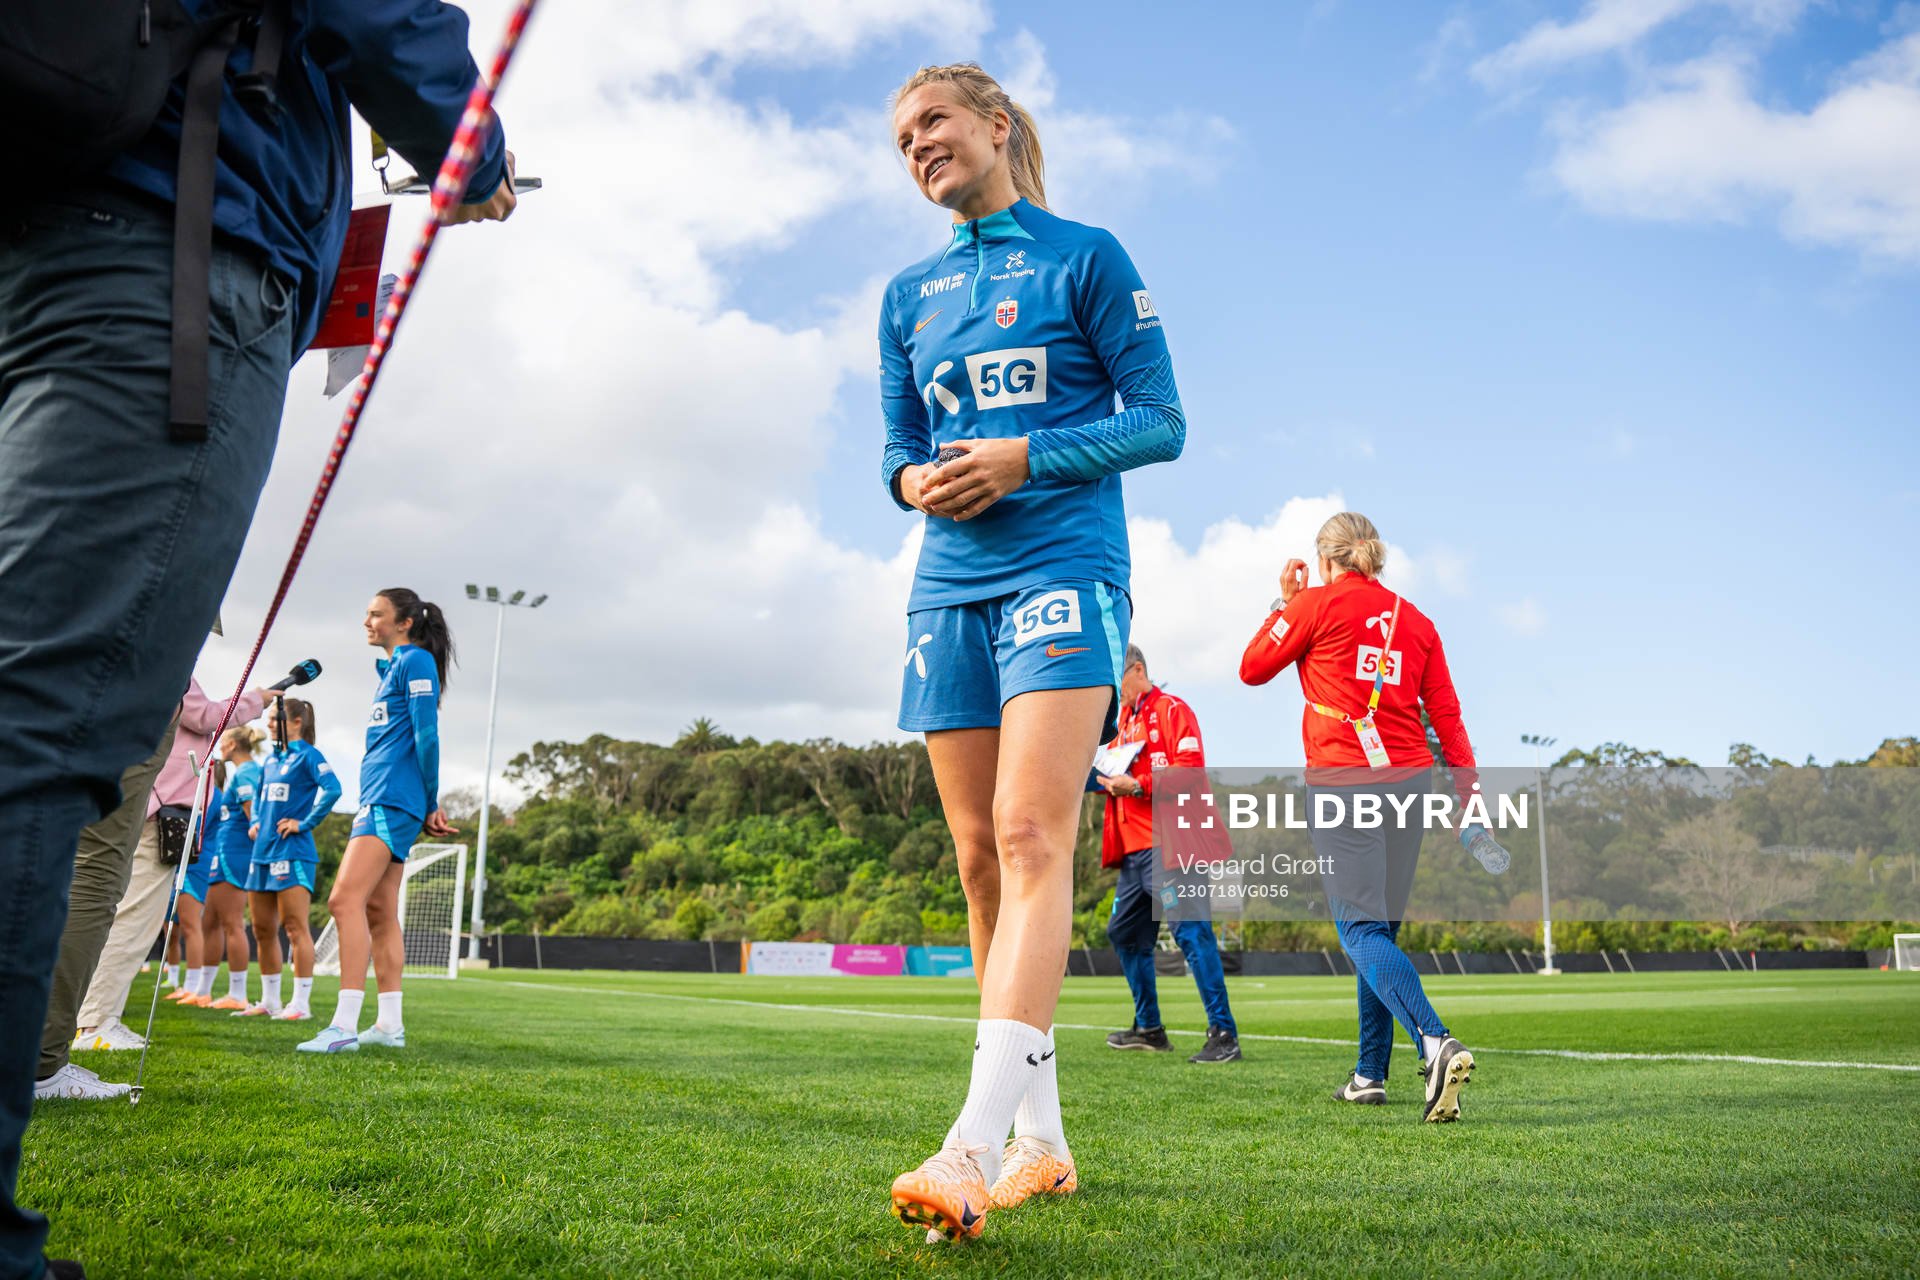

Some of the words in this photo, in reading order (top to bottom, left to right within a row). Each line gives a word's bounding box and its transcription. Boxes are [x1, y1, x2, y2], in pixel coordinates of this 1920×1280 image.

[990, 273, 1010, 281] Norsk
[1011, 268, 1035, 279] Tipping
[920, 276, 951, 299] KIWI
[979, 358, 1037, 398] 5G
[1021, 598, 1070, 634] 5G
[1361, 653, 1396, 677] 5G
